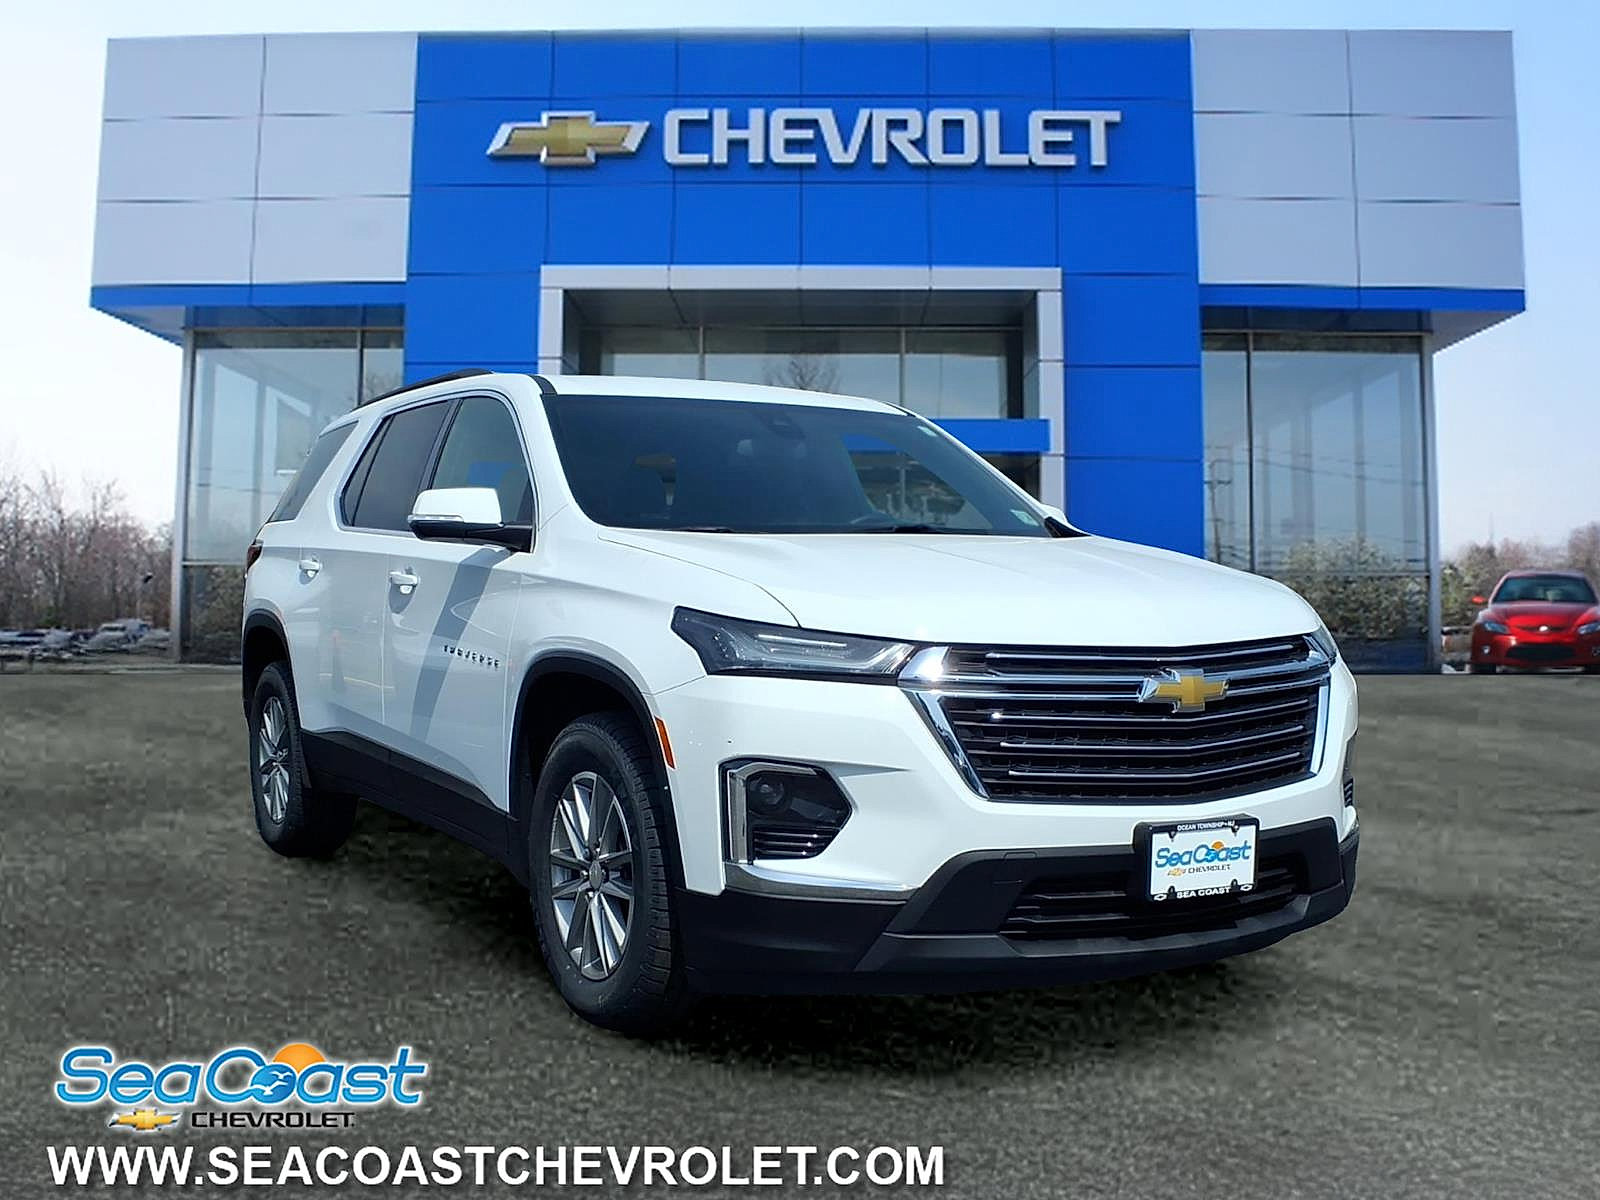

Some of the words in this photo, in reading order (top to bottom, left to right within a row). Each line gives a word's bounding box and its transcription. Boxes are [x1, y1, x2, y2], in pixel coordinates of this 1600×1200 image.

[663, 108, 1121, 167] CHEVROLET
[1177, 823, 1196, 831] OCEAN
[1188, 864, 1231, 874] CHEVROLET
[1176, 890, 1196, 899] SEA
[1198, 886, 1231, 897] COAST
